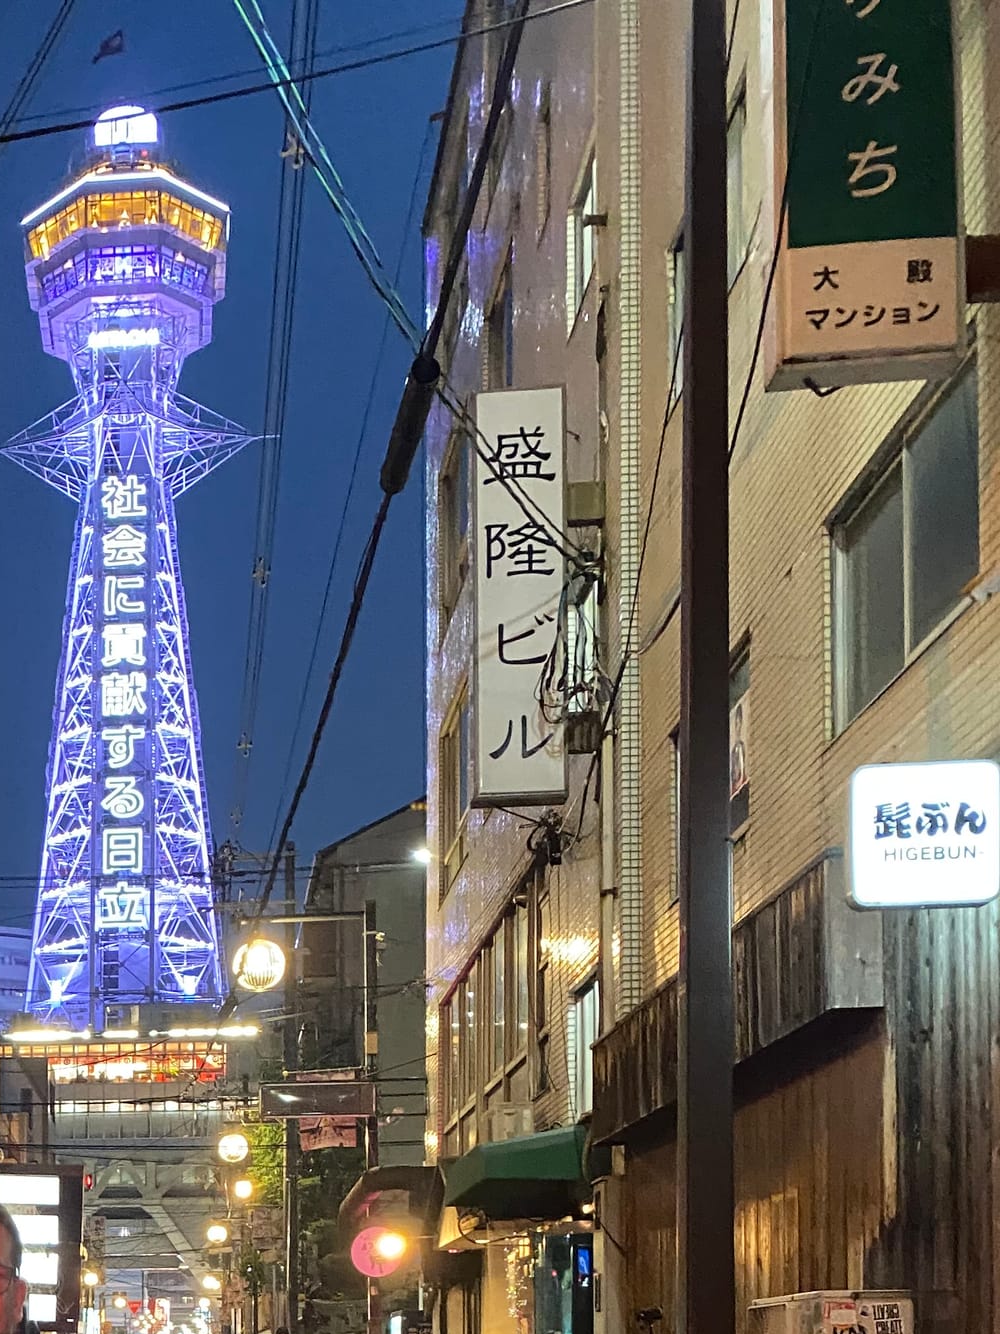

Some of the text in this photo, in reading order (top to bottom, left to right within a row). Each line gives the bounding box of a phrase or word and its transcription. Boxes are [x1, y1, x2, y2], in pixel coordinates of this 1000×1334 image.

[805, 301, 941, 331] マンション
[483, 426, 556, 760] 盛隆ビル
